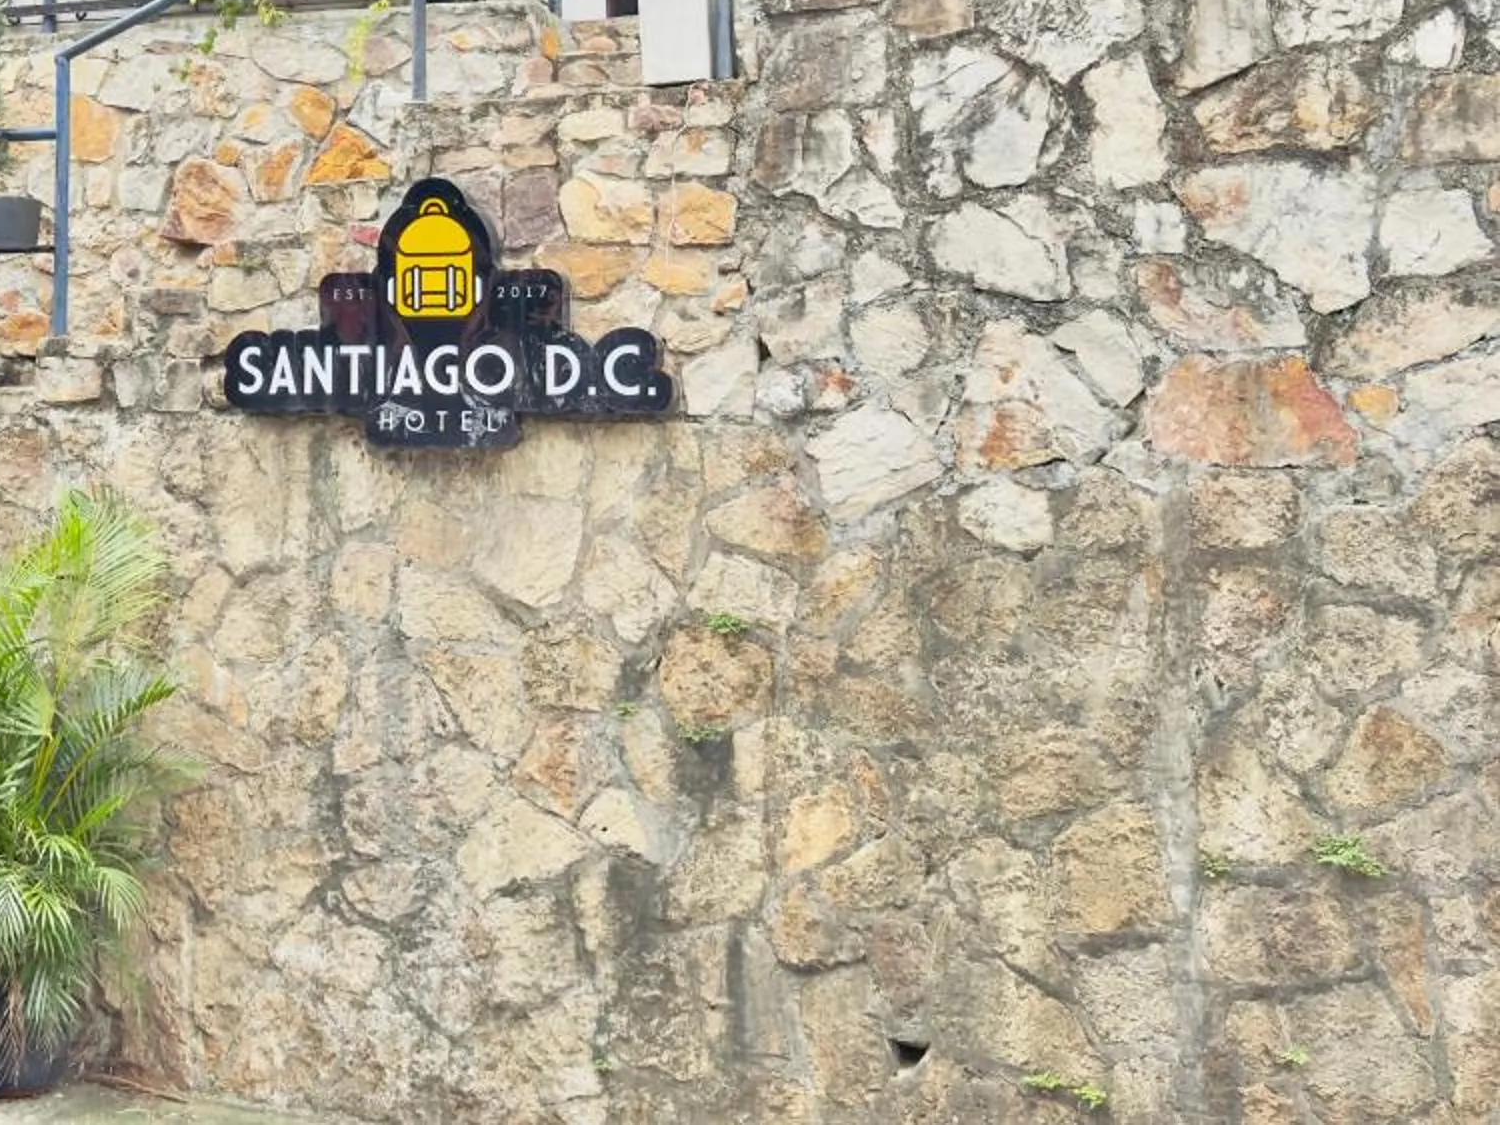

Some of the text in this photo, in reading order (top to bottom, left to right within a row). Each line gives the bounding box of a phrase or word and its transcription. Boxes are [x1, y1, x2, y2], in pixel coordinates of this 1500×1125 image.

[497, 285, 548, 299] 2017
[238, 344, 657, 396] SANTIAGO D.C.
[379, 410, 497, 433] HOTEL
